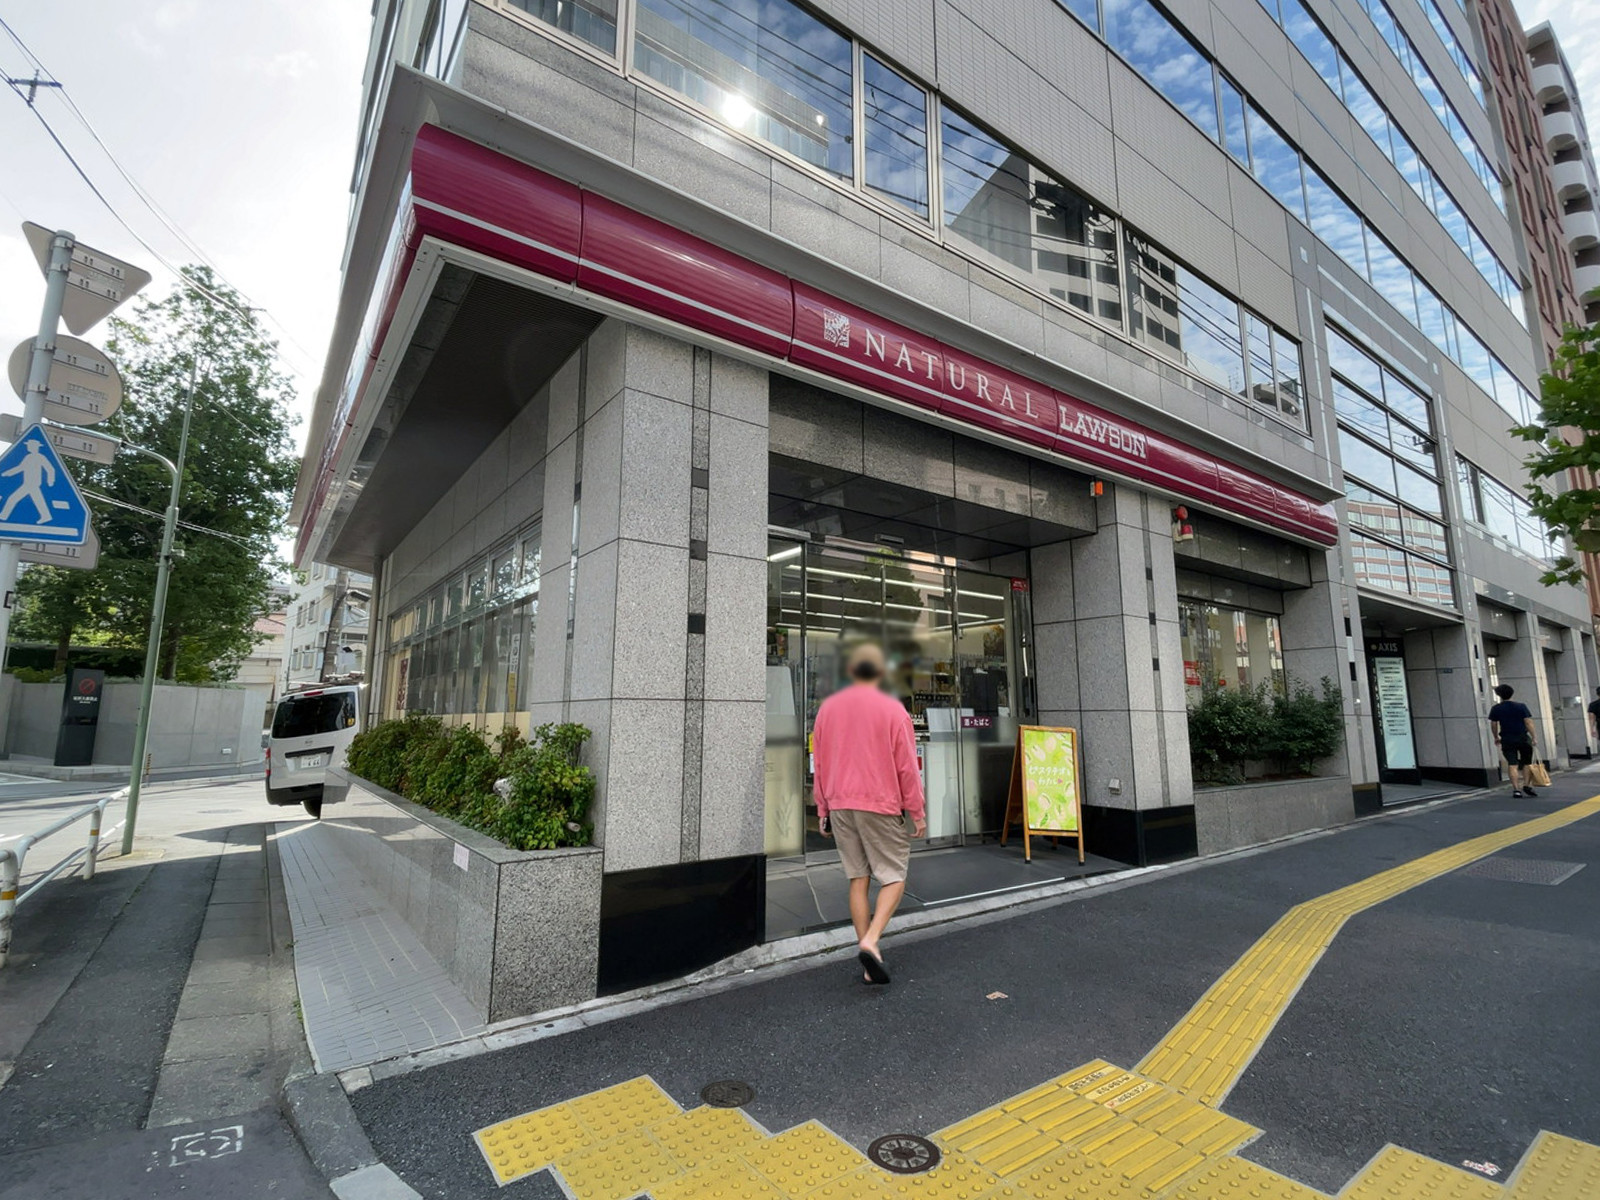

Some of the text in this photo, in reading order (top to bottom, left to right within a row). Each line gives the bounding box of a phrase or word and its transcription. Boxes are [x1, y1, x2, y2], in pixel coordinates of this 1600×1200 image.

[864, 328, 1146, 459] NATURAL LAWSON
[1378, 642, 1398, 652] AXIS
